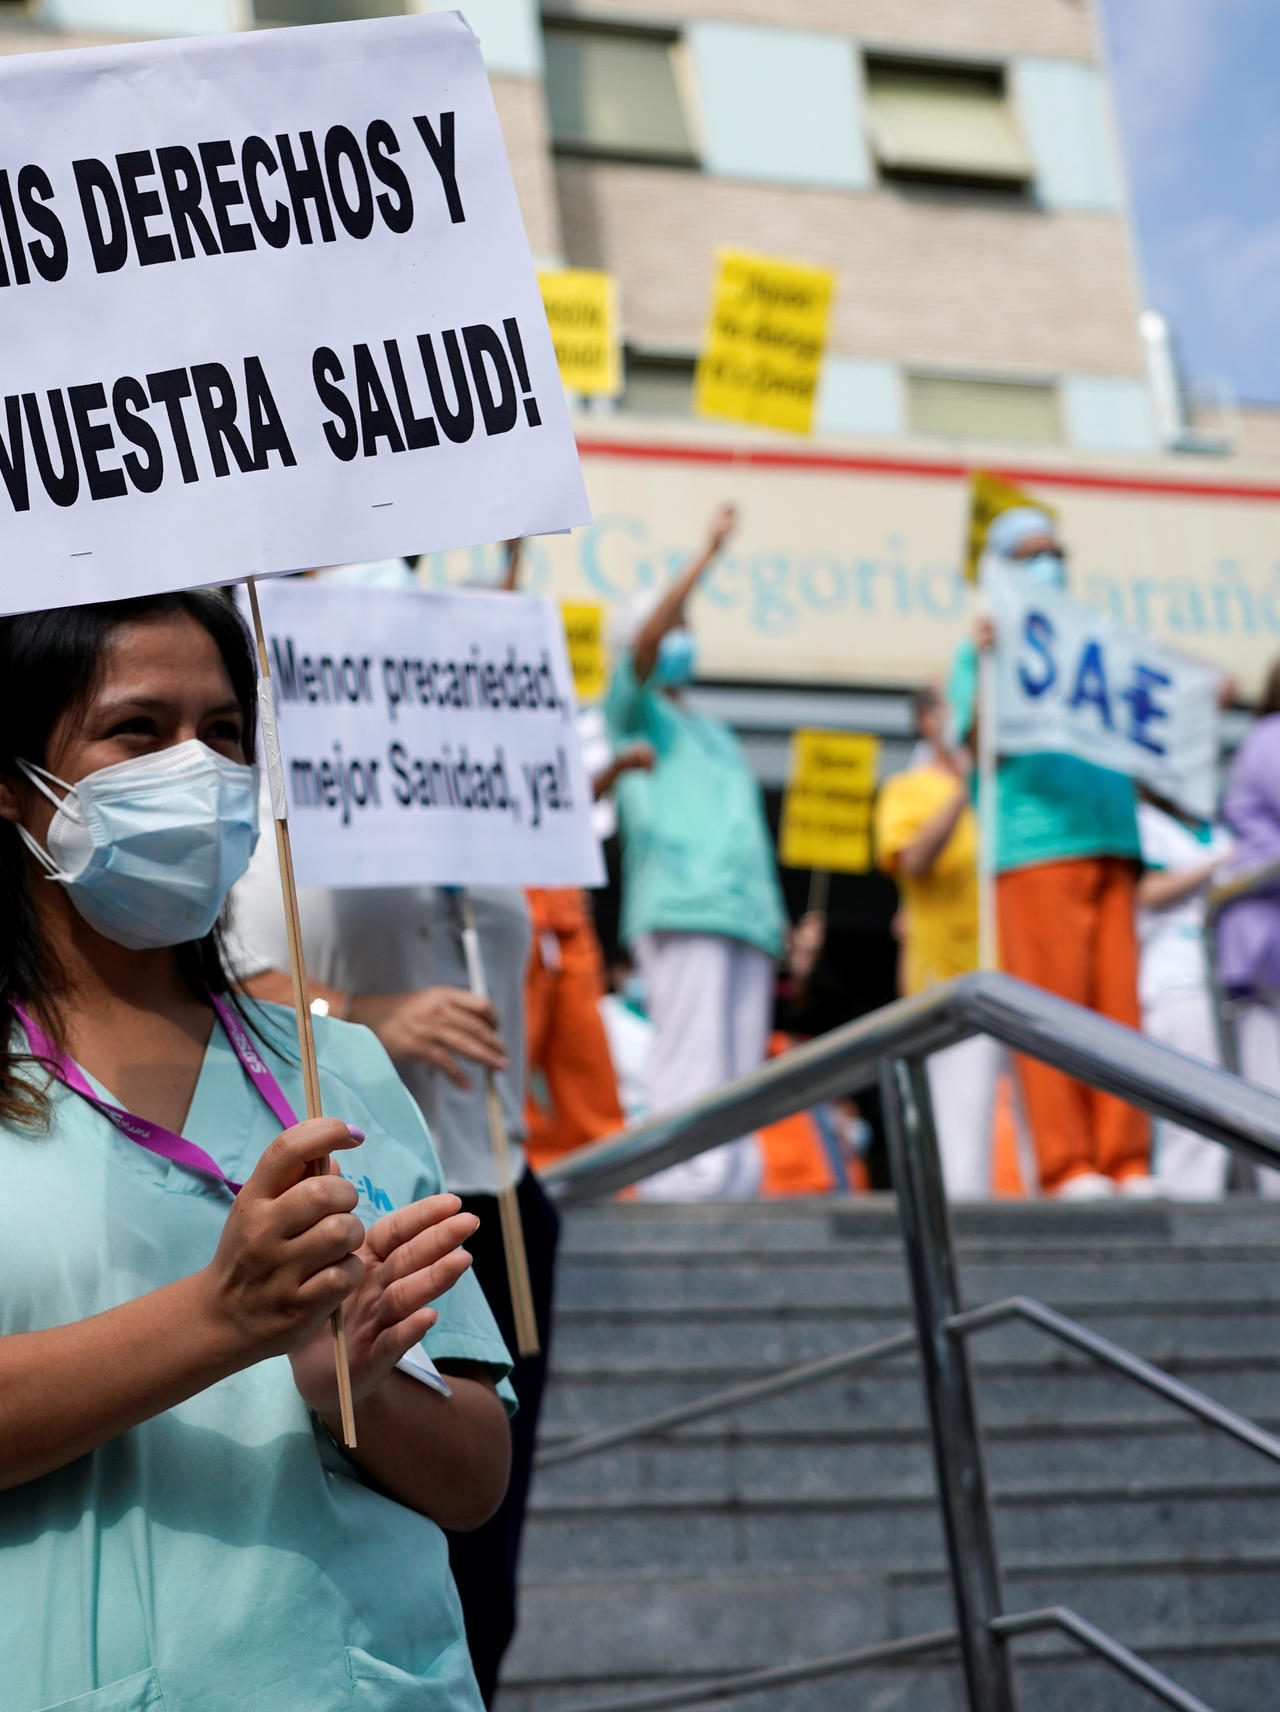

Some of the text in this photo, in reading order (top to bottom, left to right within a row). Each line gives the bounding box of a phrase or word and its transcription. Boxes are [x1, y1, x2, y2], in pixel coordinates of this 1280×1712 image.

[71, 119, 414, 274] DERECHOS
[412, 111, 466, 224] Y
[312, 317, 543, 462] SALUD!
[381, 645, 571, 722] precariedad,
[288, 739, 573, 829] mejor Sanidad, ya!
